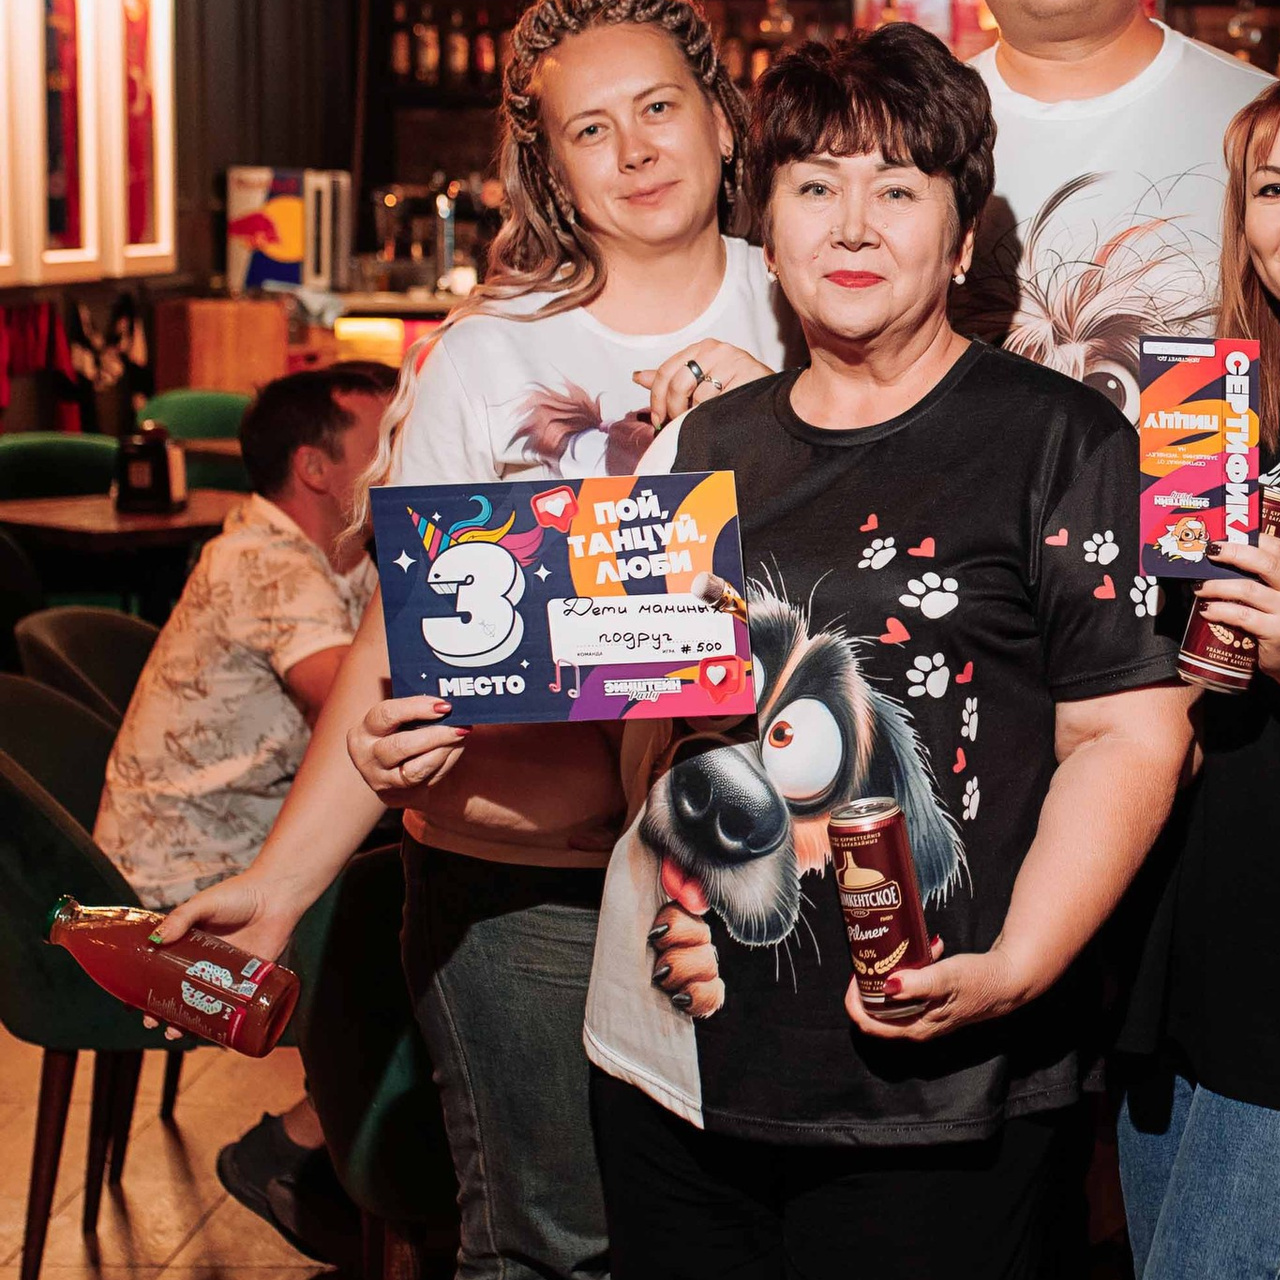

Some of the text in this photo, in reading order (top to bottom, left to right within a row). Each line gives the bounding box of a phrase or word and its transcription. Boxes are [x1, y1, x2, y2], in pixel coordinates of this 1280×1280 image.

[1143, 410, 1219, 432] ПИЦЦУ
[1225, 351, 1250, 545] СЕРТИФИКА
[593, 489, 669, 526] ПОЙ,
[567, 513, 707, 559] ТАНЦУЙ,
[595, 548, 693, 585] ЛЮБИ
[421, 541, 526, 667] 3
[562, 596, 628, 617] Дети
[598, 631, 674, 650] подруг
[439, 675, 526, 698] МЕСТО
[847, 923, 889, 942] Pilsner
